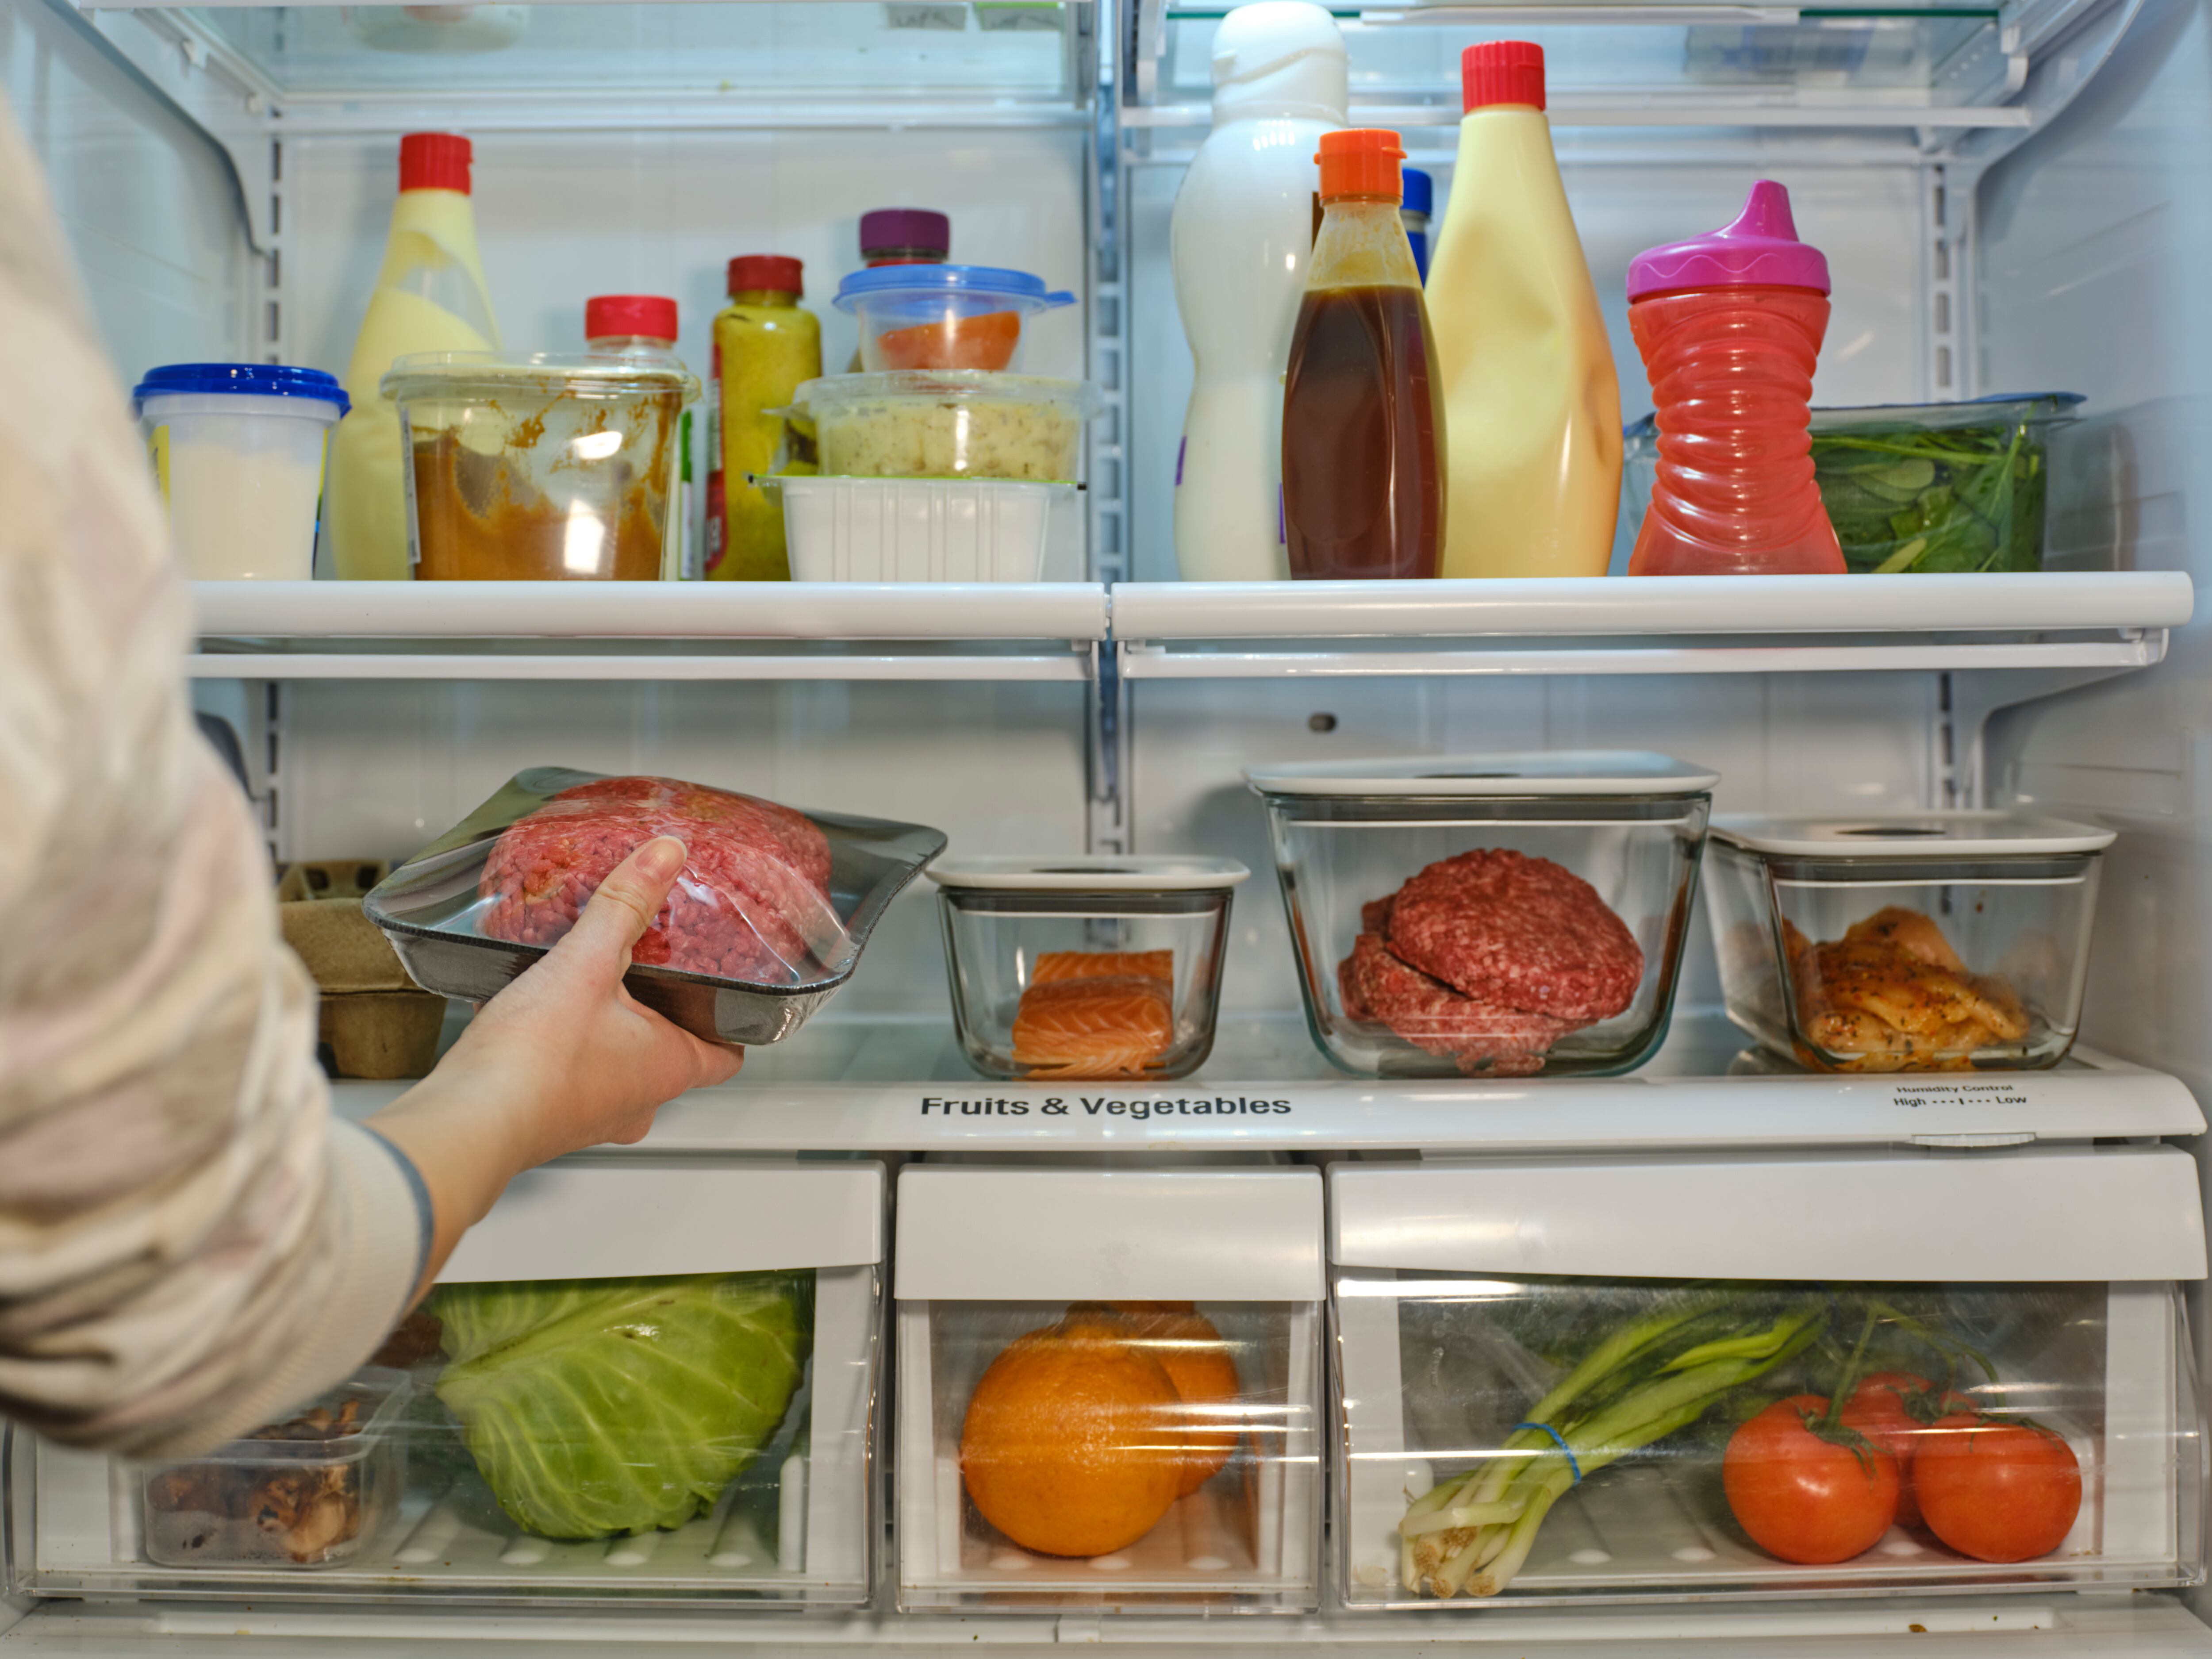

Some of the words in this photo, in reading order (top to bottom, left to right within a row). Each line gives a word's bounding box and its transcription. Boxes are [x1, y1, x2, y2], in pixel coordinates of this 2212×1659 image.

[921, 1097, 1029, 1115] Fruits
[1041, 1098, 1069, 1115] &
[1079, 1097, 1291, 1120] Vegetables
[1893, 1097, 1927, 1107] High
[1995, 1096, 2027, 1104] Low
